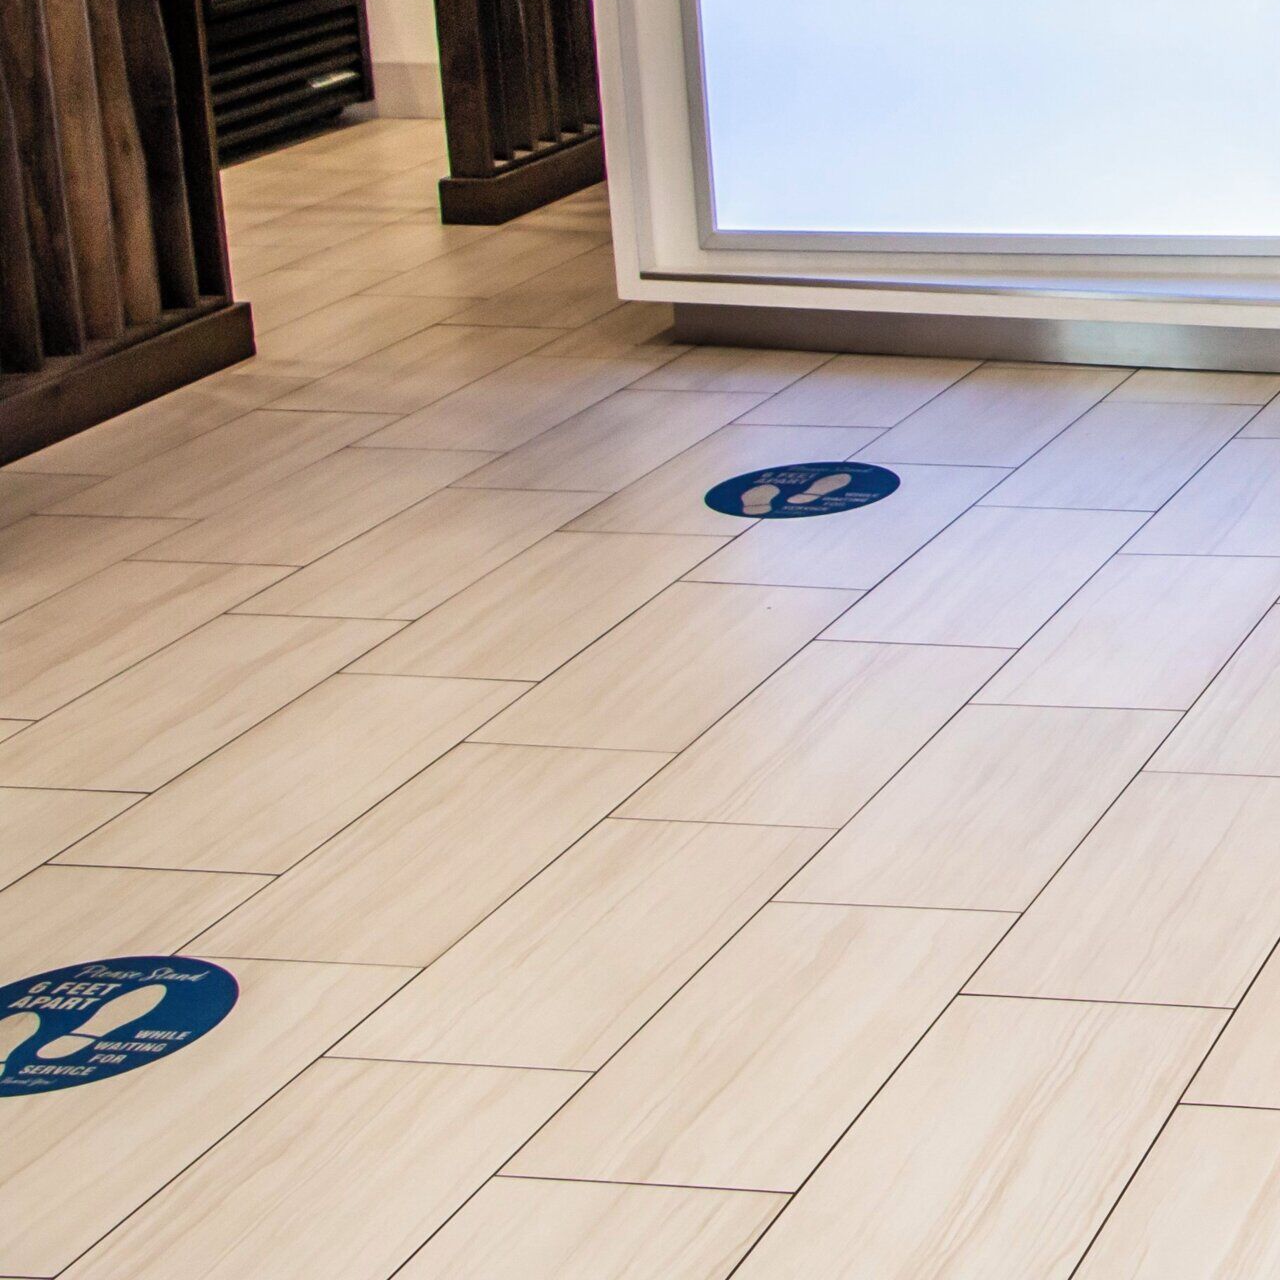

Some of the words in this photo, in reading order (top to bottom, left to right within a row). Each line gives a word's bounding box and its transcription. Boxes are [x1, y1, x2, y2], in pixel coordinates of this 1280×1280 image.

[74, 965, 143, 980] Please
[139, 966, 211, 983] Stand
[27, 981, 51, 994] 6
[50, 982, 123, 996] FEET
[7, 996, 101, 1011] APART
[134, 1030, 193, 1041] WHILE
[93, 1041, 168, 1052] WAITING
[86, 1053, 128, 1064] FOR
[18, 1064, 97, 1076] SERVICE
